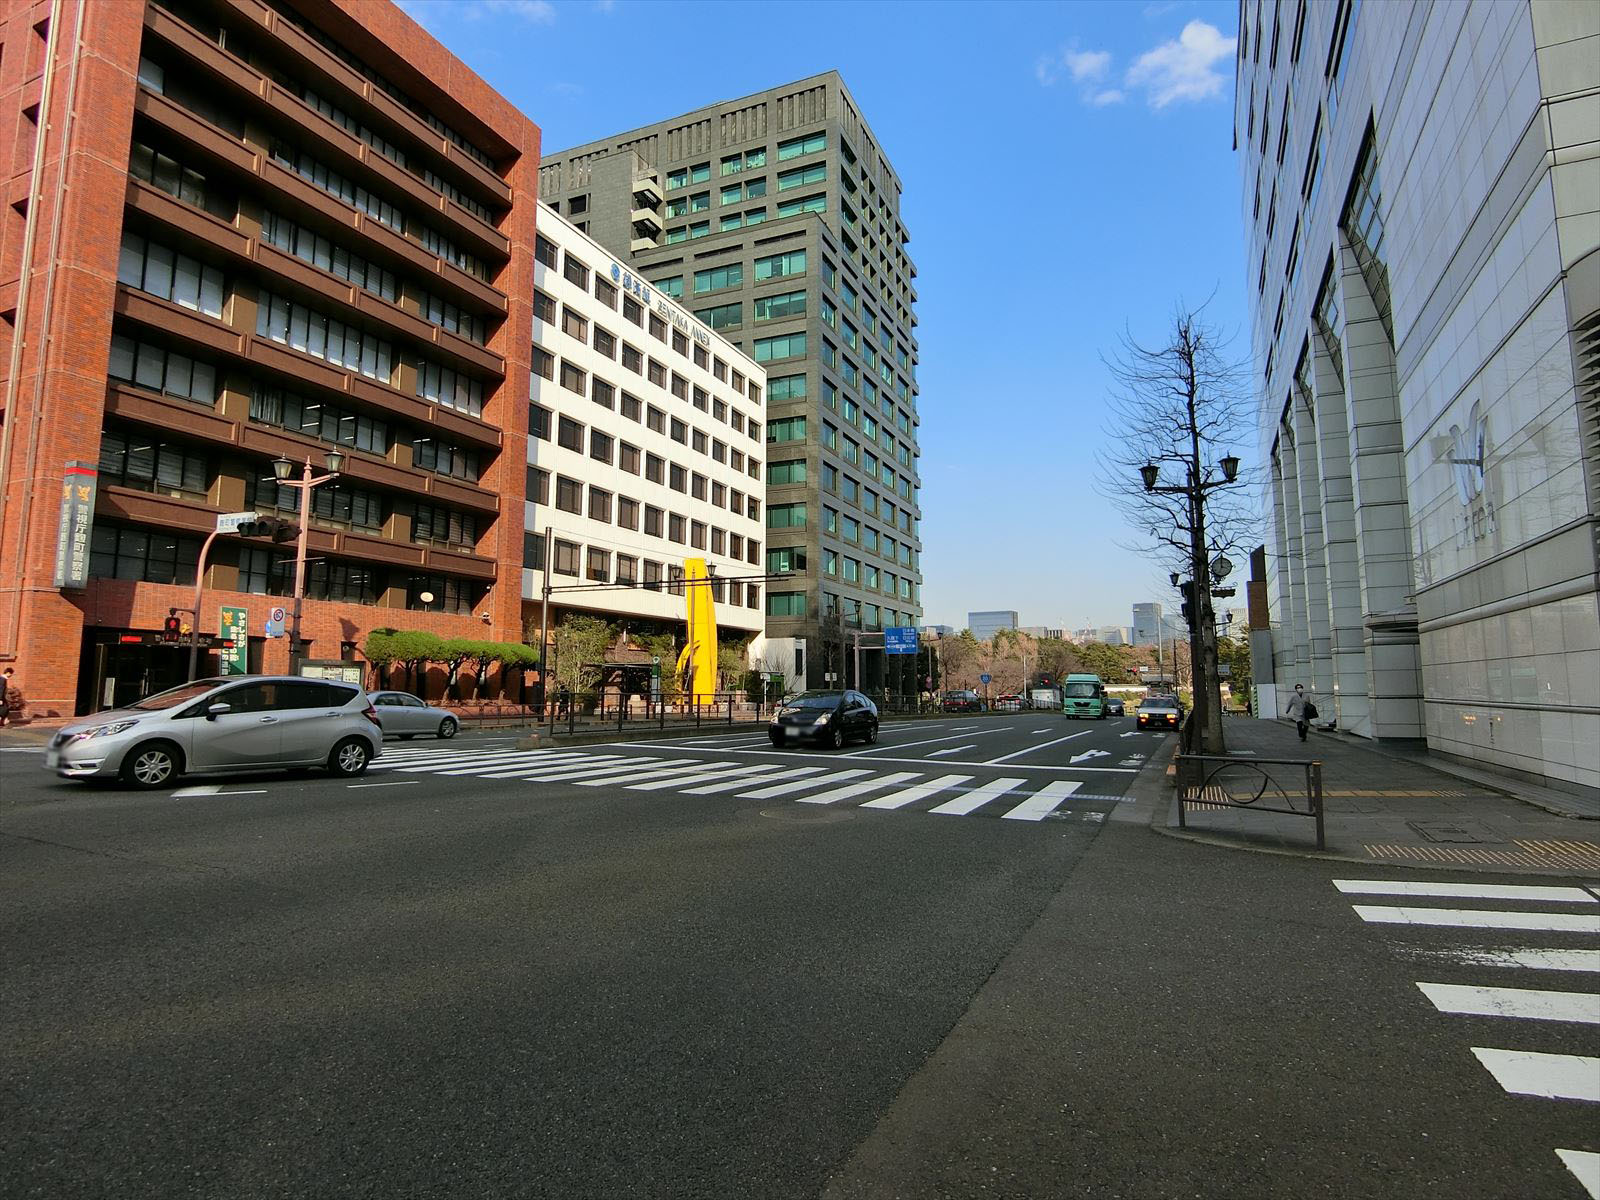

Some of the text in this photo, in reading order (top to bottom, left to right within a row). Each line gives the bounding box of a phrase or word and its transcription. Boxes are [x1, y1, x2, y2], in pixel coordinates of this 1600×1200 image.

[238, 612, 246, 648] やさしさが
